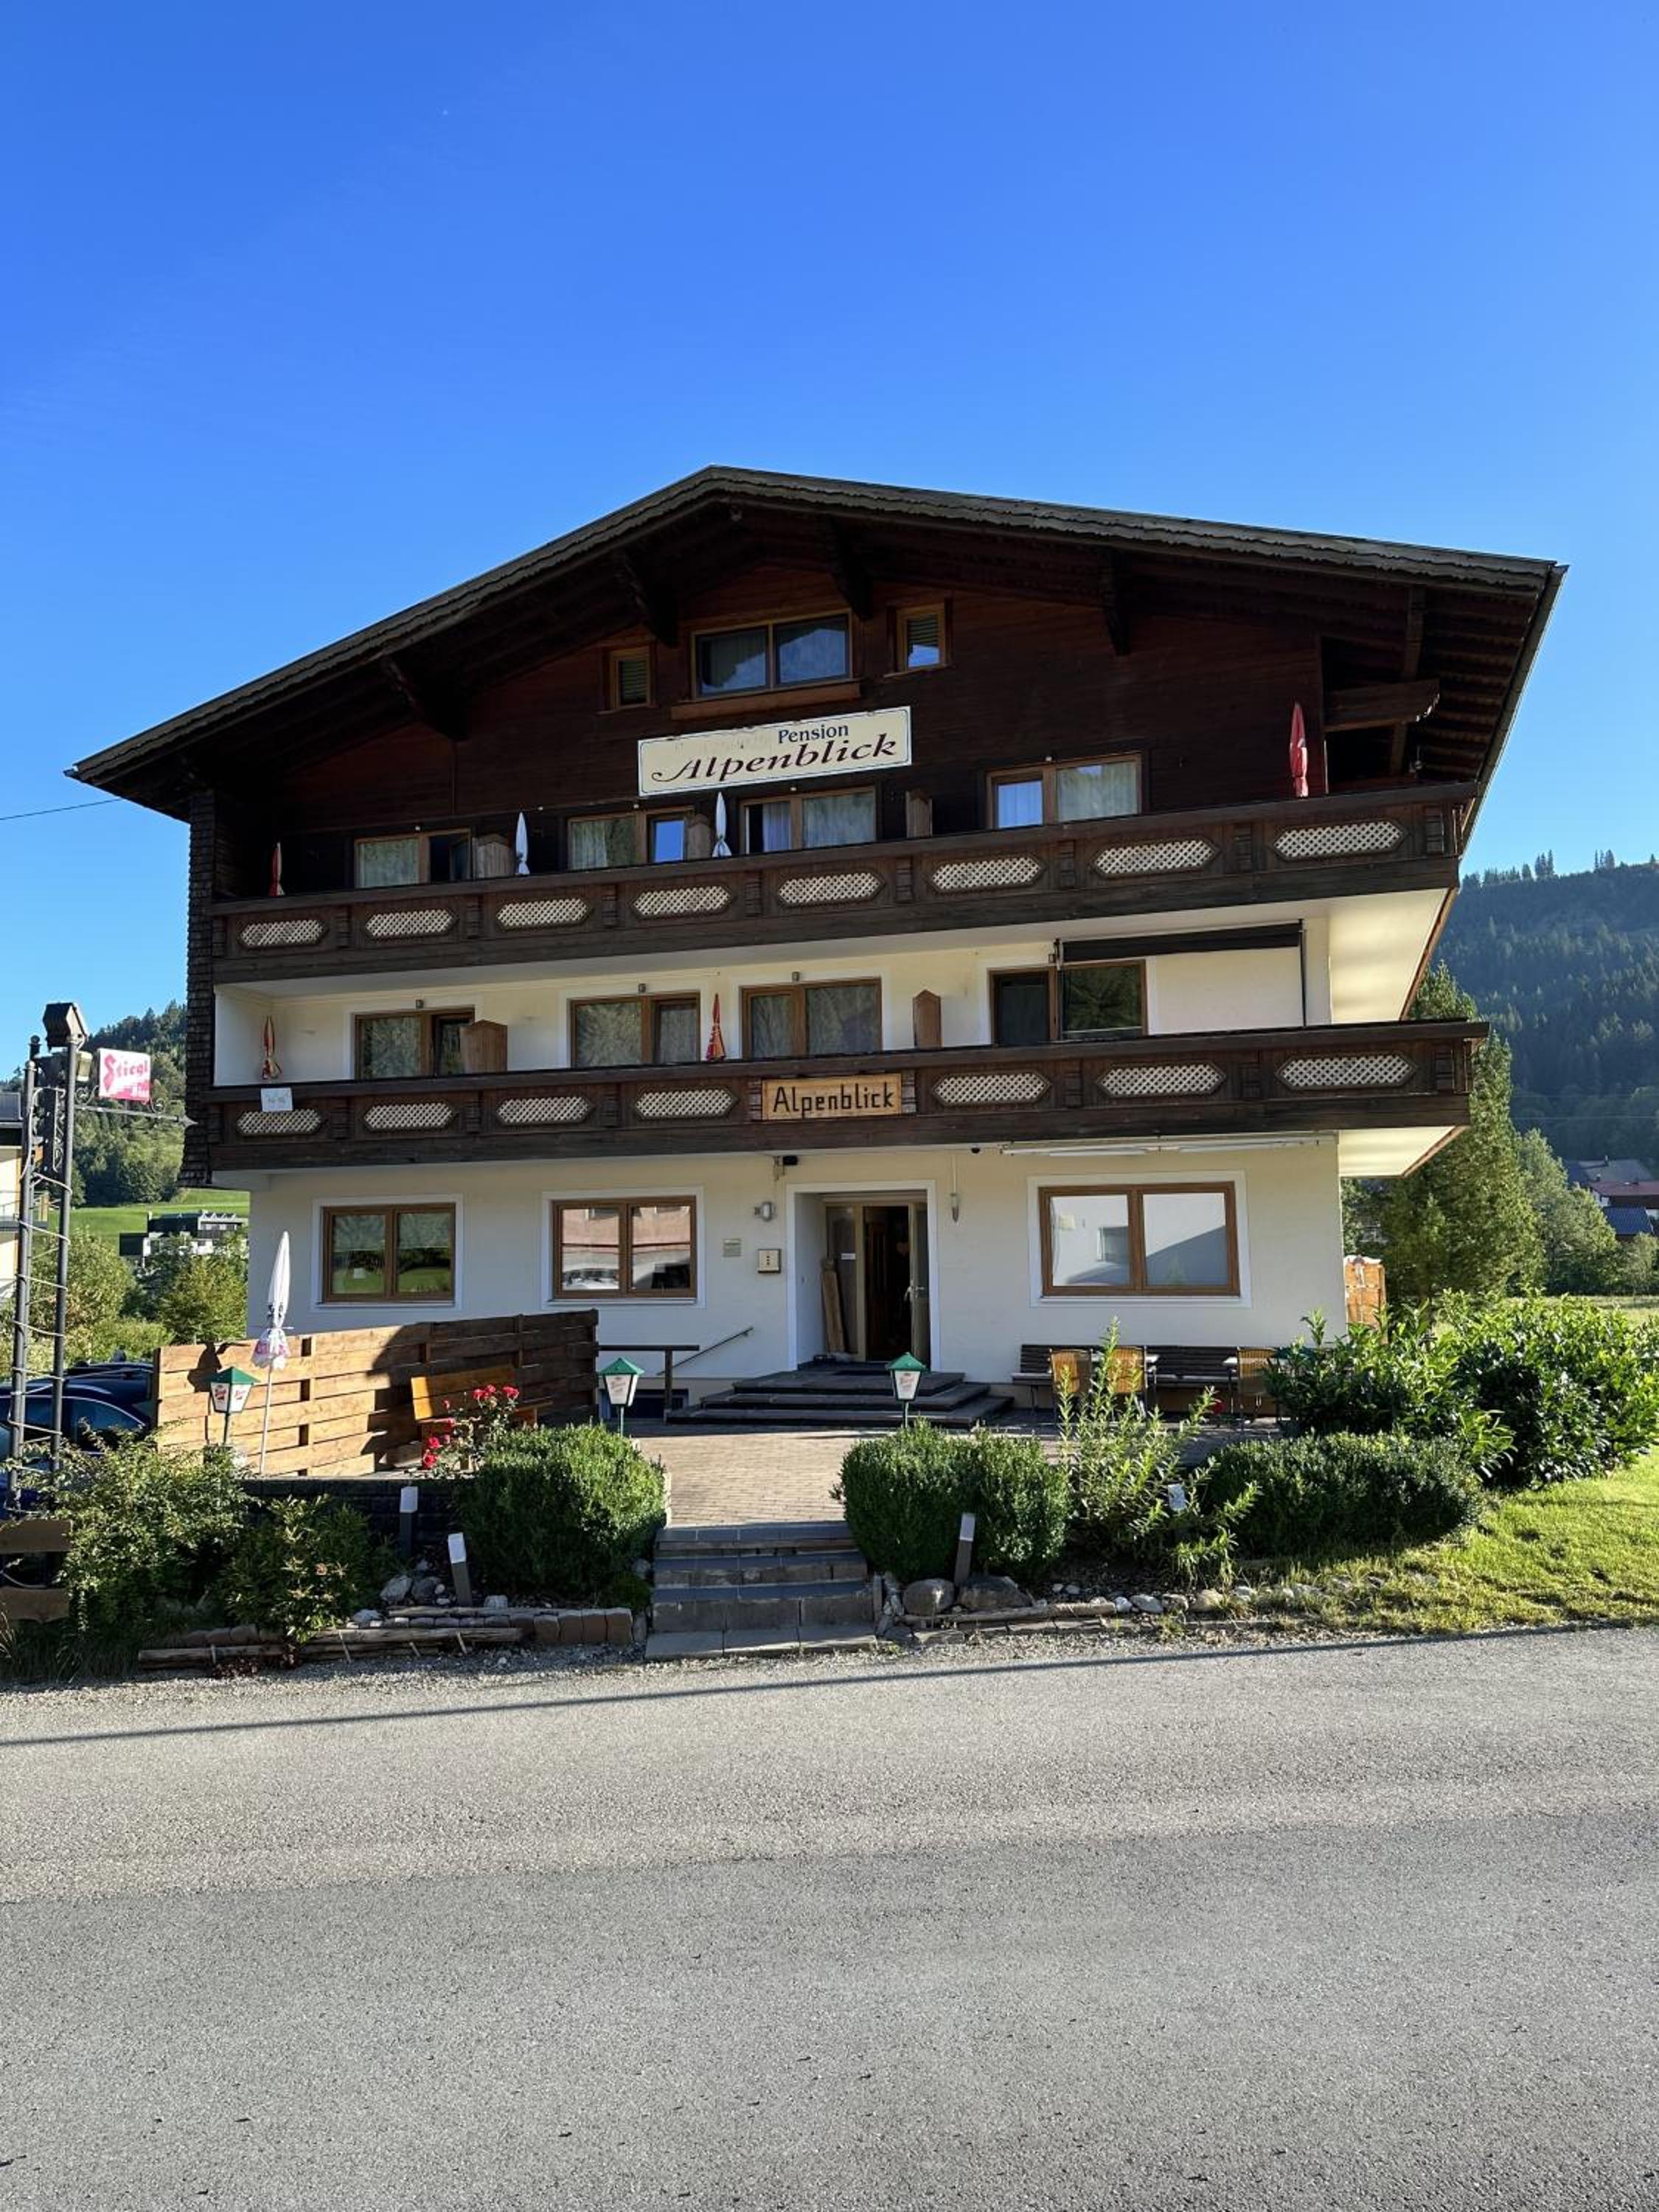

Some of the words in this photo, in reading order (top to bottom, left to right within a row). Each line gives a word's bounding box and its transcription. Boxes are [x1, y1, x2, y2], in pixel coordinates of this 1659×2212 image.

[778, 724, 849, 744] Pension
[651, 733, 897, 782] Alpenblick
[773, 1082, 894, 1119] Alpenblick
